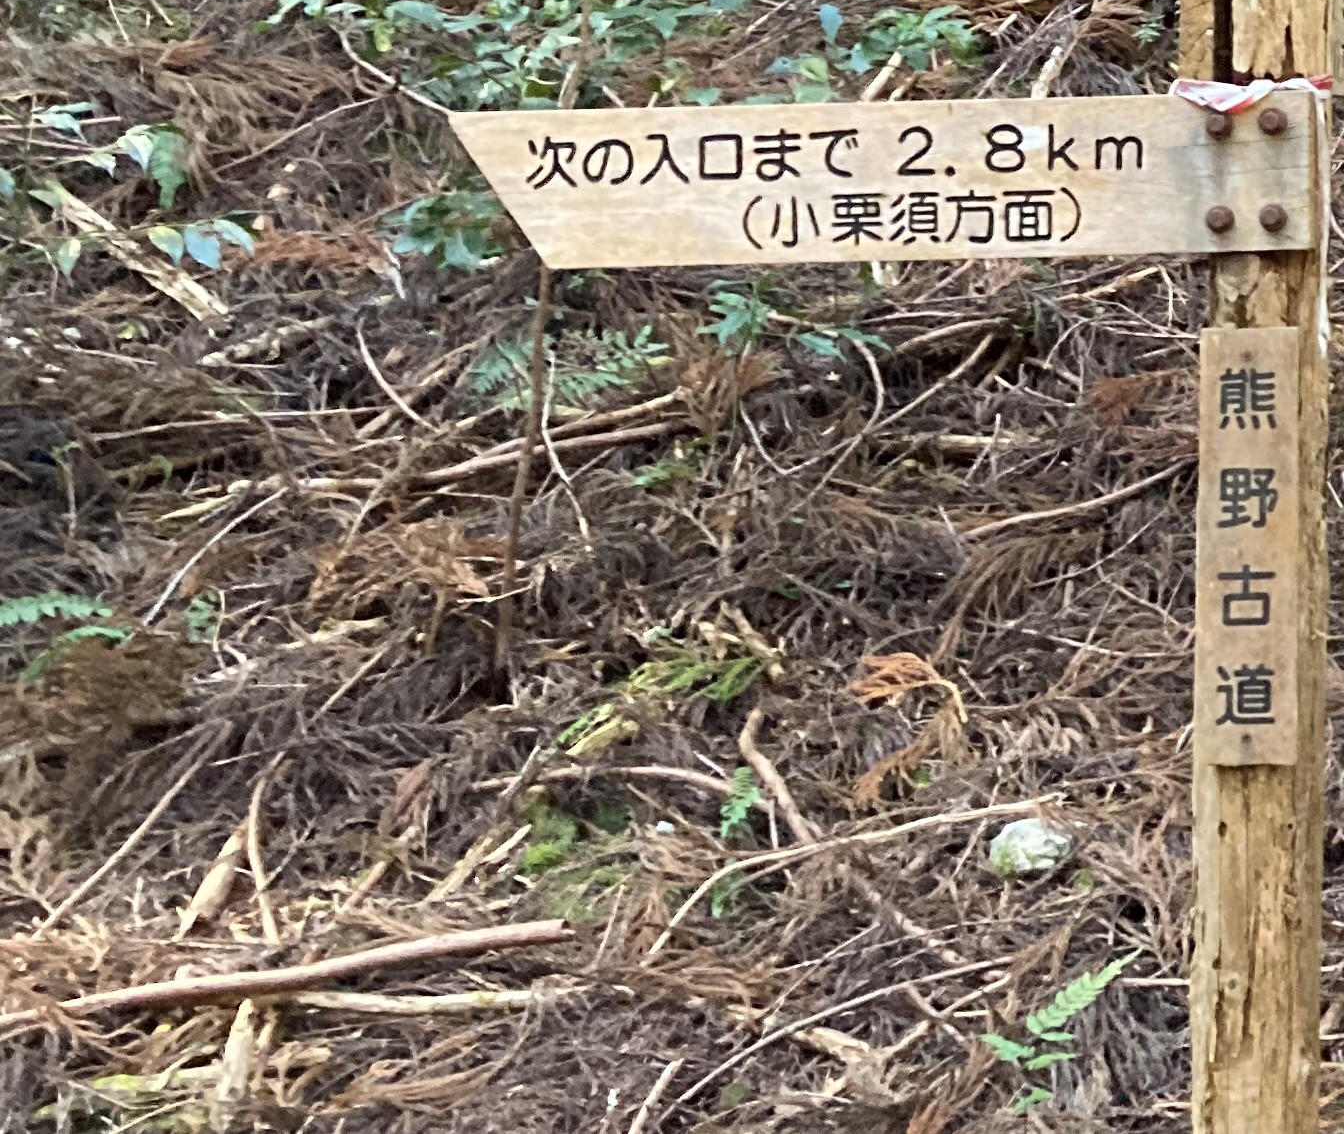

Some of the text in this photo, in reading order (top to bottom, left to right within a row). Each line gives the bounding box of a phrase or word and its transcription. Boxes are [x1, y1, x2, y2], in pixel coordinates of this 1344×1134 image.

[526, 122, 1147, 188] 次の入口まで 2.8km
[742, 187, 1083, 249] (小栗須方面)
[1215, 367, 1279, 726] 熊野古道
